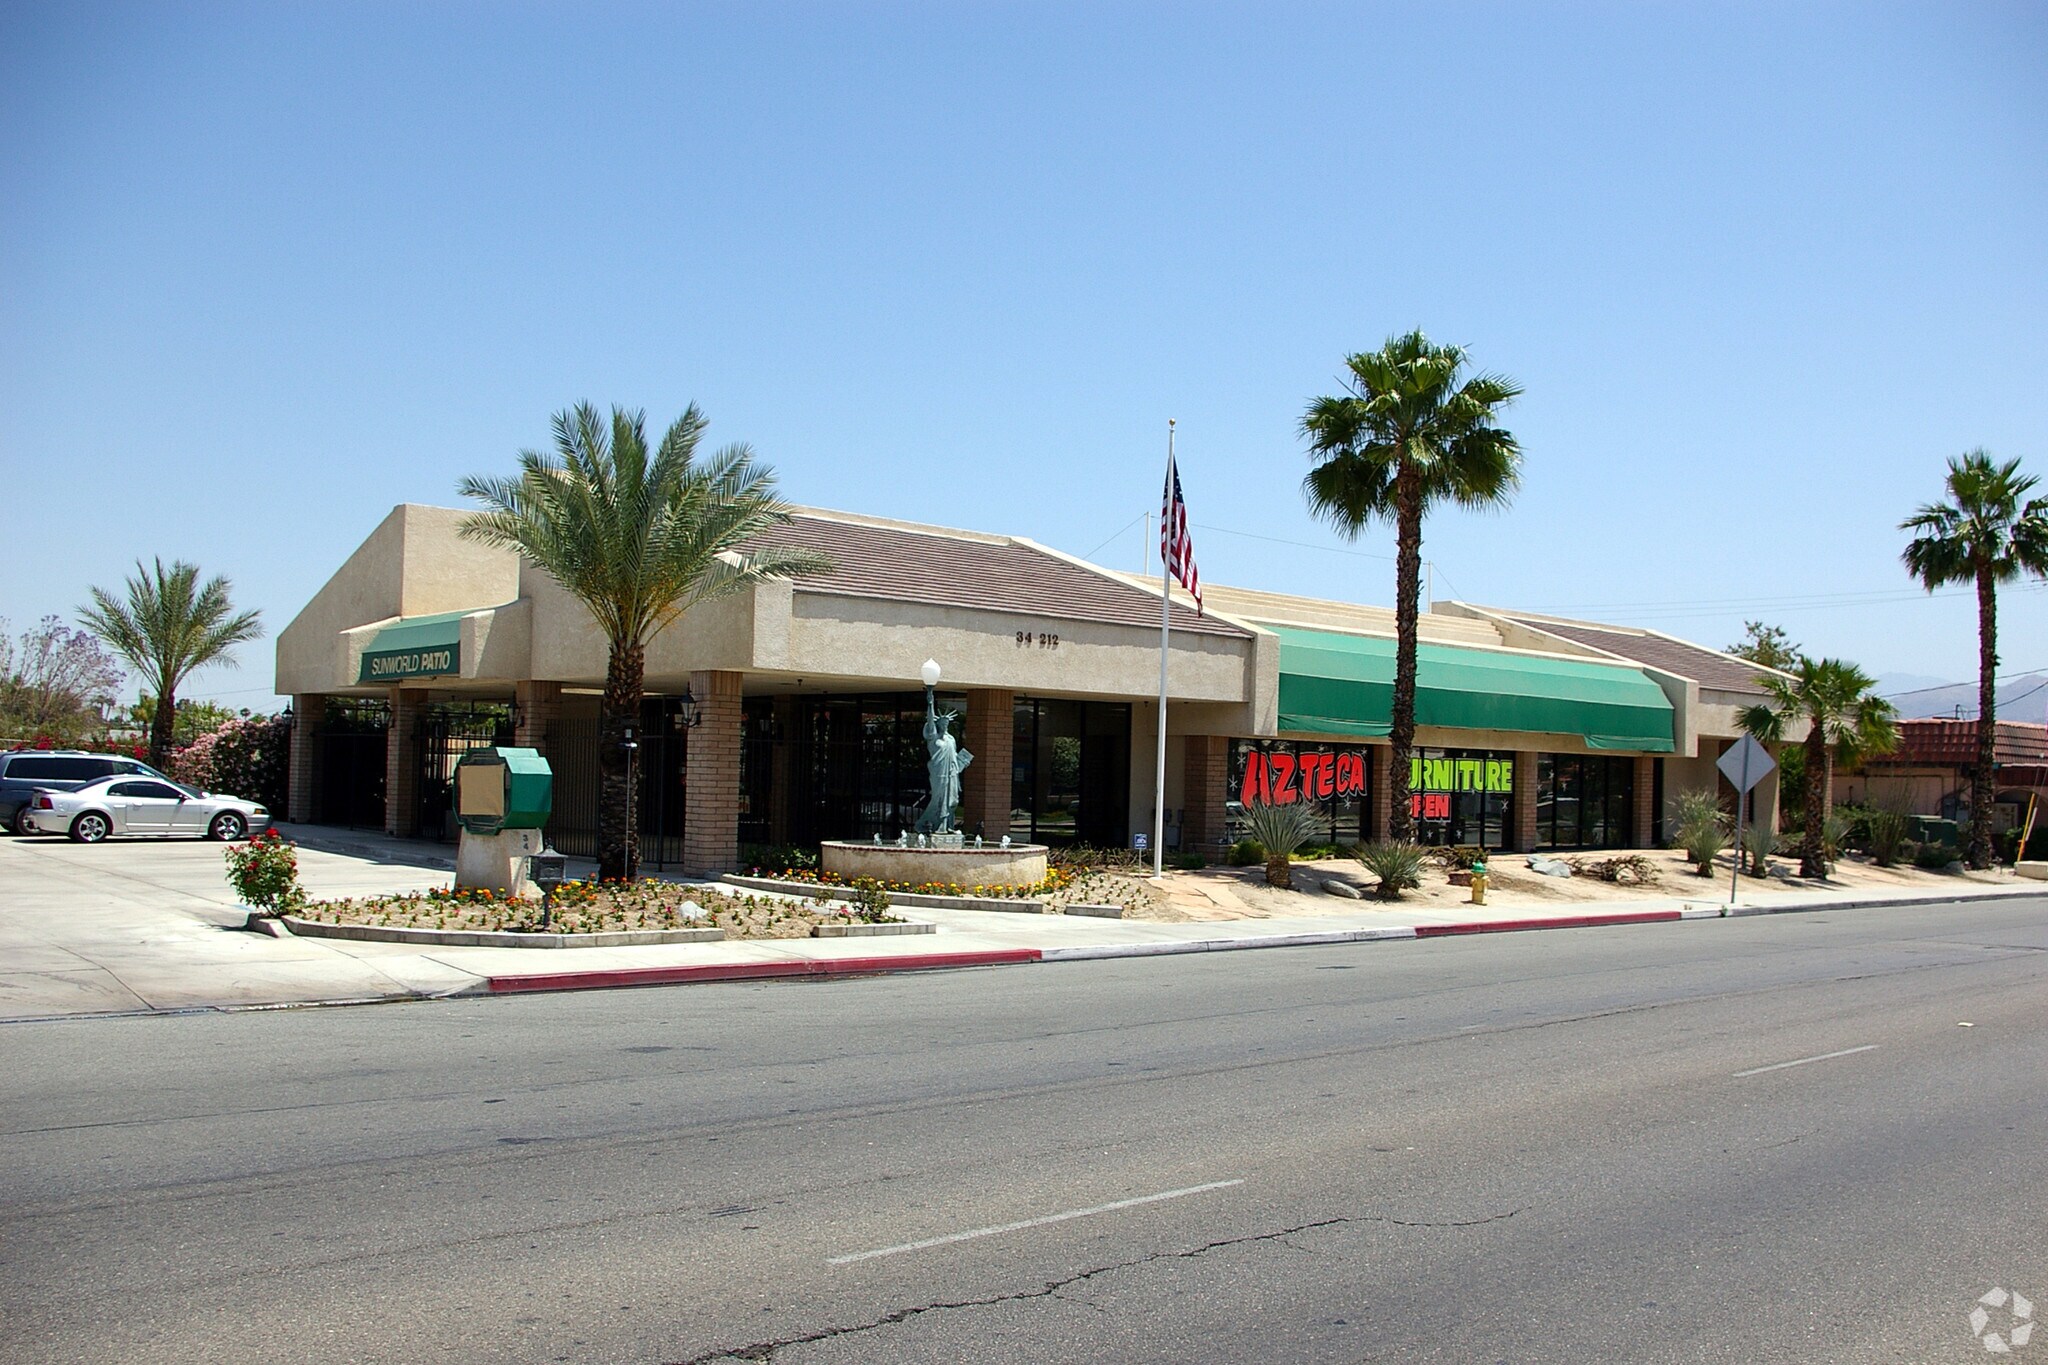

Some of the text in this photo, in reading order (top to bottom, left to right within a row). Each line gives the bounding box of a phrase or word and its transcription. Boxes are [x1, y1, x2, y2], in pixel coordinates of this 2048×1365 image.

[1016, 631, 1059, 645] 34 212
[371, 651, 450, 675] SUNWORLD PATIO
[1241, 751, 1513, 808] AZTECA URNITURE
[1411, 794, 1451, 822] PEN
